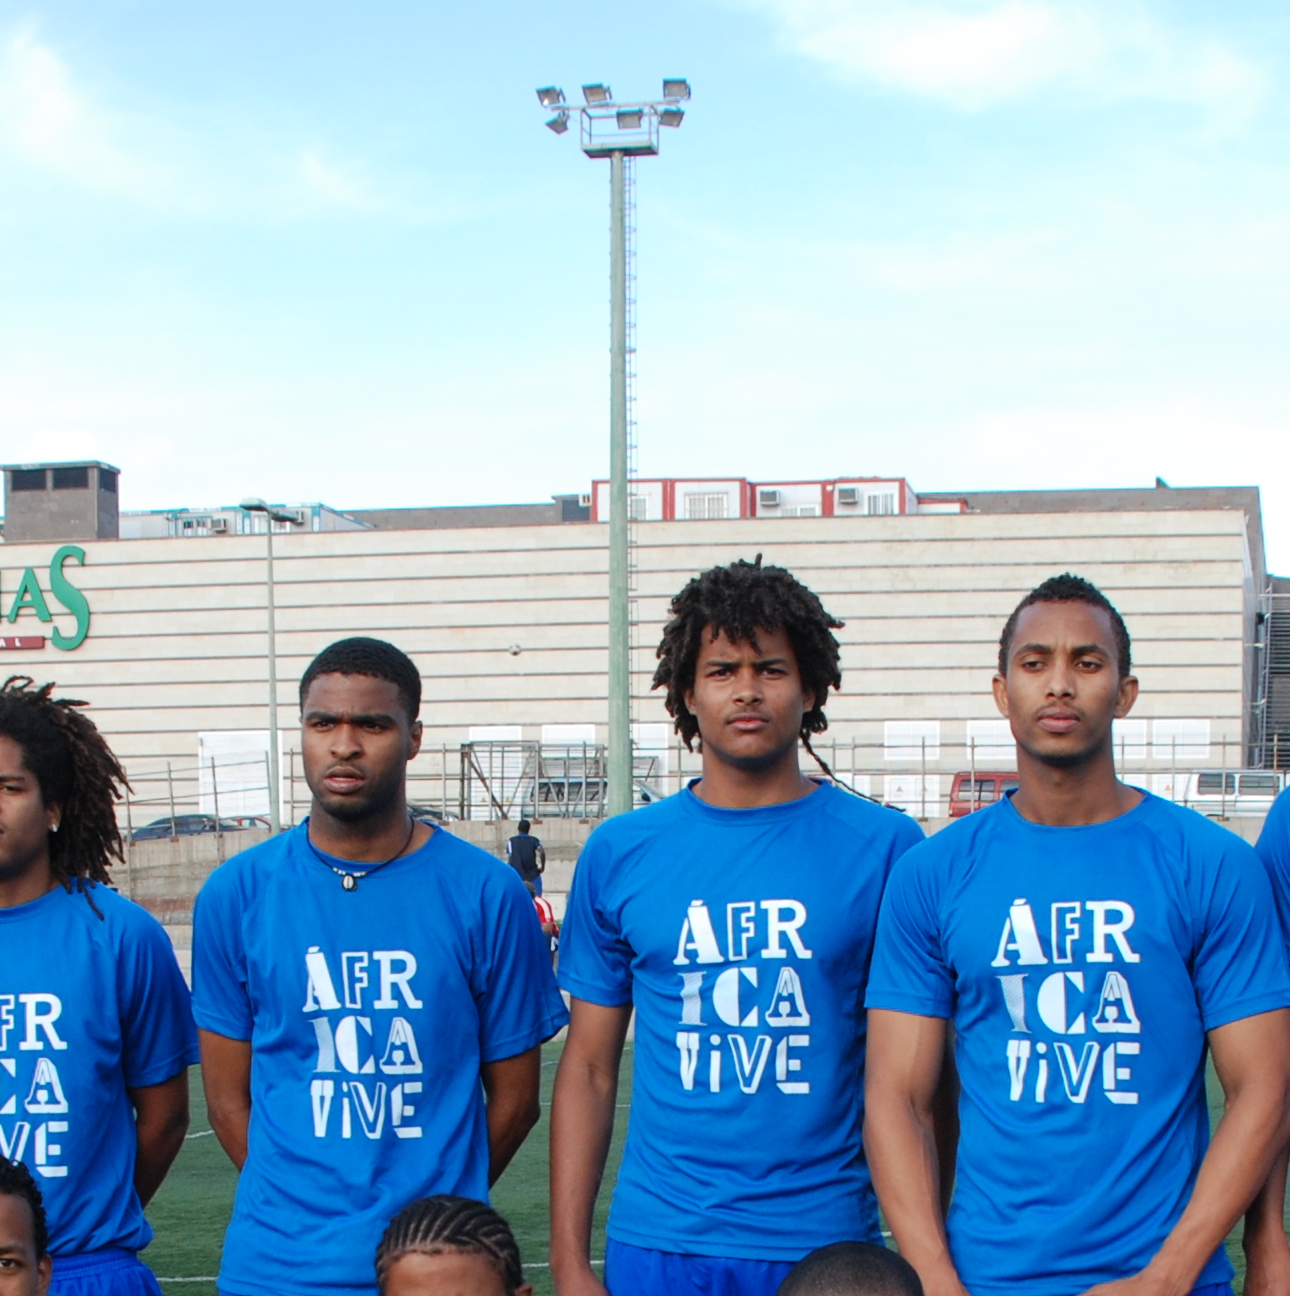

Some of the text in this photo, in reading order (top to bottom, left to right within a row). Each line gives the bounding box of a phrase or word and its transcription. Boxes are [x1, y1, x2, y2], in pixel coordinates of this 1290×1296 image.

[677, 967, 810, 1027] ICA
[994, 971, 1140, 1034] ICA
[307, 1015, 423, 1074] ICA
